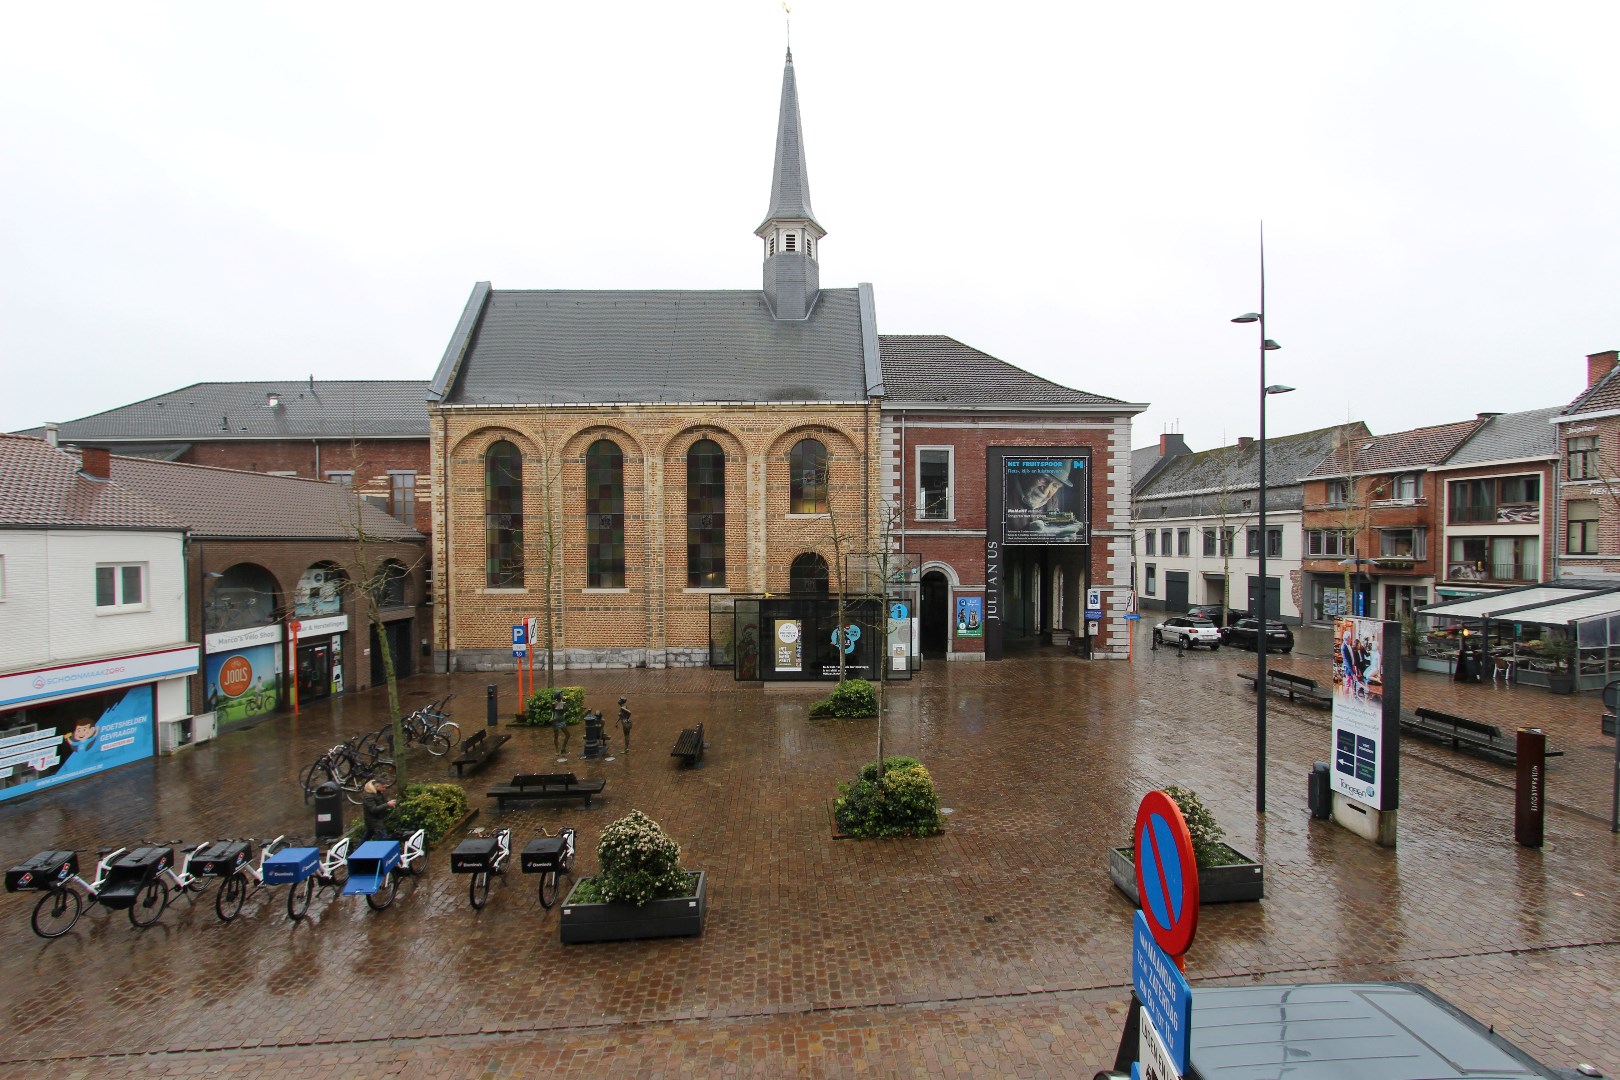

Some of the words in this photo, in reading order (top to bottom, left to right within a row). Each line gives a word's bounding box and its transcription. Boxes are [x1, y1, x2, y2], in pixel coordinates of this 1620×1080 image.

[988, 541, 999, 620] JULIANUS
[259, 630, 275, 639] Shop
[514, 628, 524, 642] P
[47, 666, 126, 685] SCHOONMAAKZORG
[224, 666, 248, 686] JOOLS
[100, 714, 147, 732] POETSHELDEN
[1148, 942, 1176, 1002] MAANDAG
[1149, 967, 1178, 1031] ZATERDAG
[1141, 1017, 1158, 1063] LADEN
